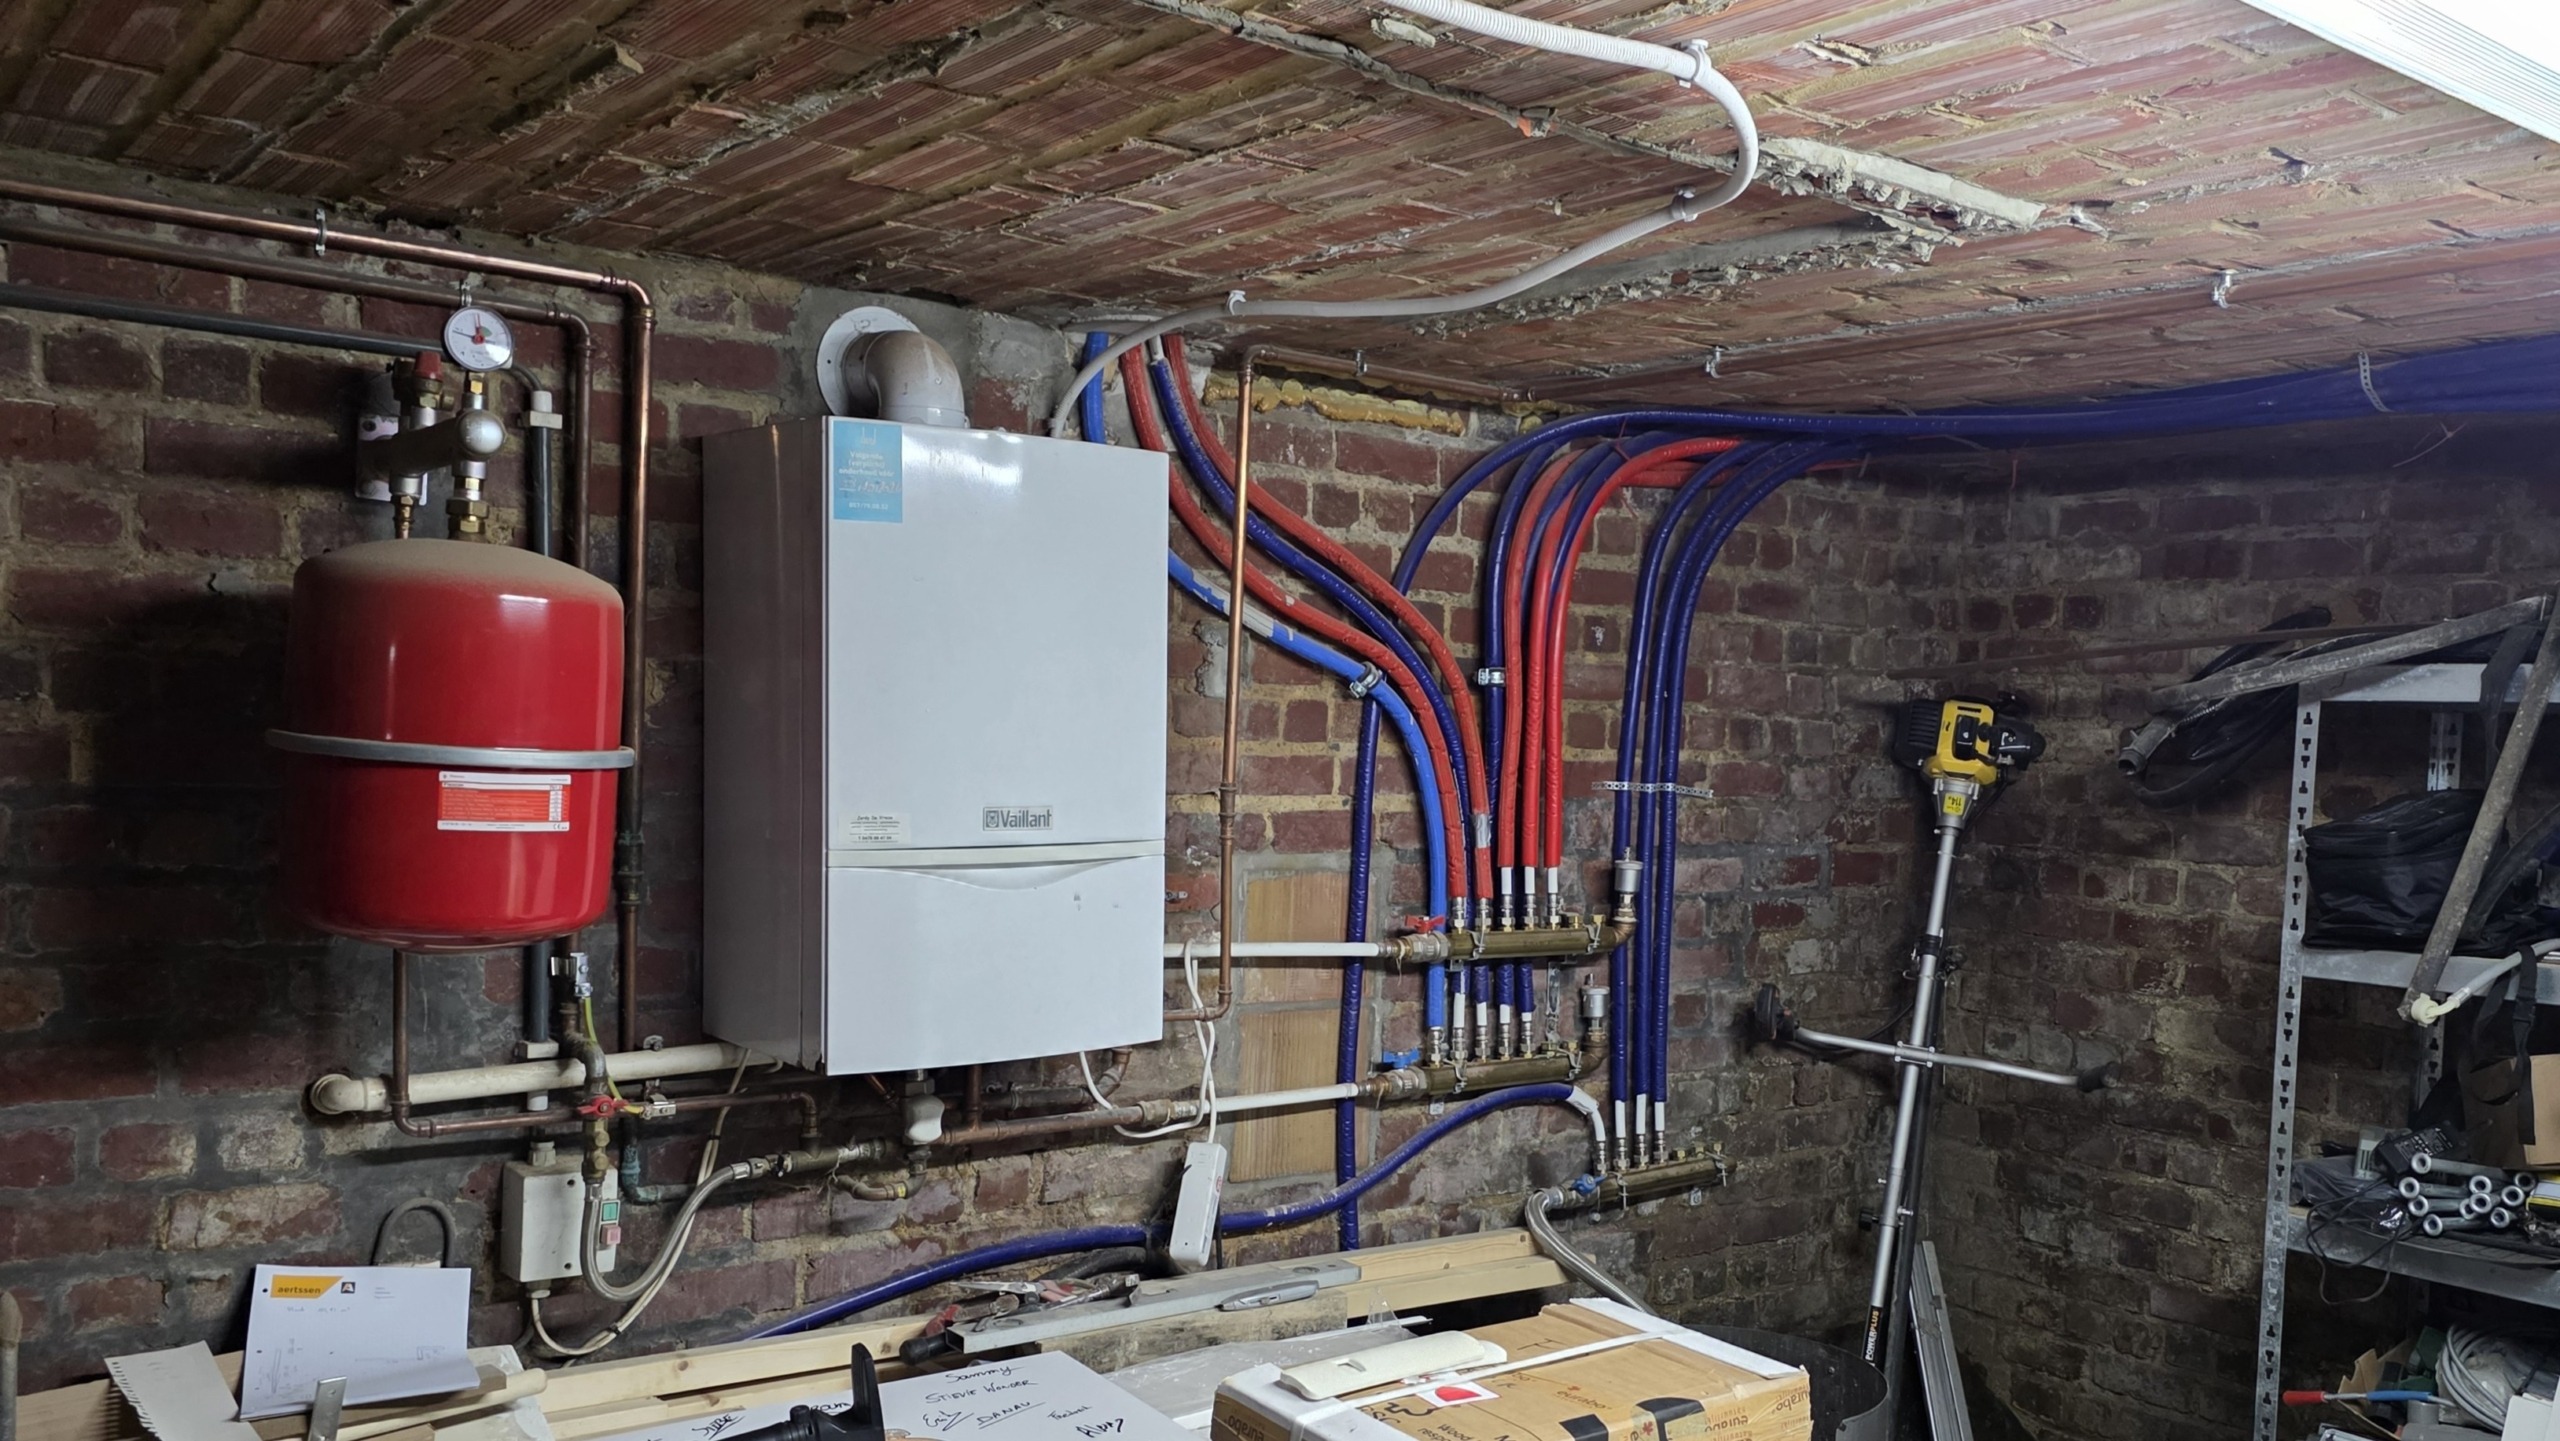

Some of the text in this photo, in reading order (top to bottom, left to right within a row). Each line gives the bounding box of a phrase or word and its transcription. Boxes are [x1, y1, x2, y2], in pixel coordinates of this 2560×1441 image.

[1000, 809, 1052, 828] Vaillant
[277, 1285, 321, 1294] aertssen
[1865, 1310, 1880, 1361] POWERPLUS
[1556, 1391, 1608, 1409] eurabo
[1227, 1415, 1265, 1441] eurabo
